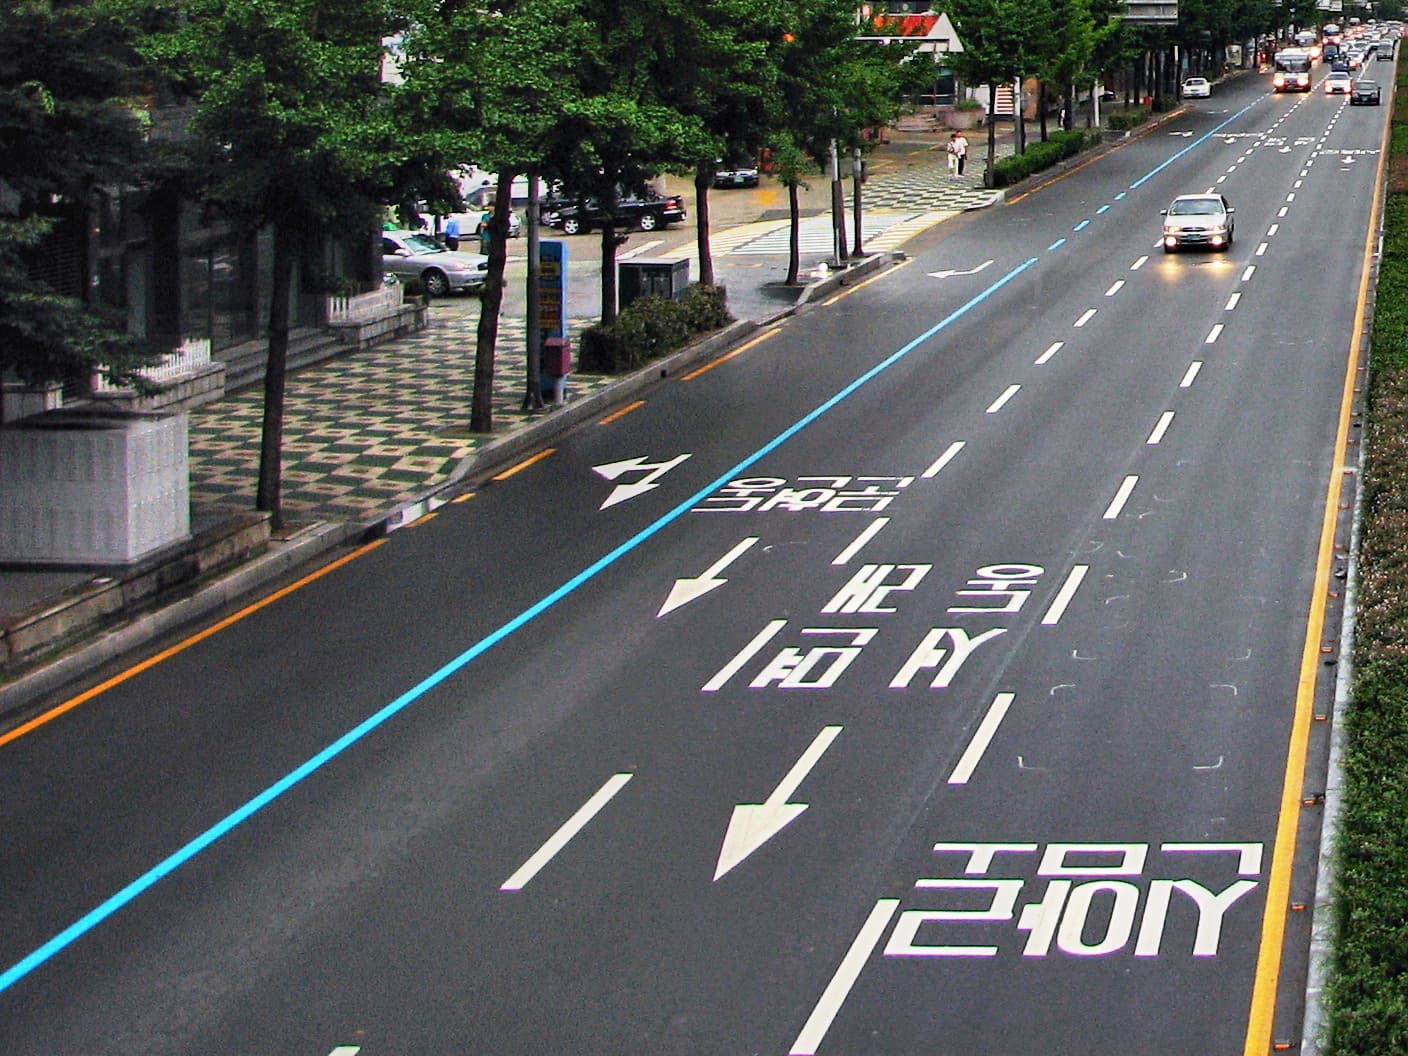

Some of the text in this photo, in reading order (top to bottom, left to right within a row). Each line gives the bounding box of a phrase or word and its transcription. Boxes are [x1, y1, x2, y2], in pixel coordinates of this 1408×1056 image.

[690, 476, 916, 513] 문현동
[820, 563, 1046, 614] 동래
[748, 627, 1009, 688] 서면
[882, 842, 1264, 957] 신암로
